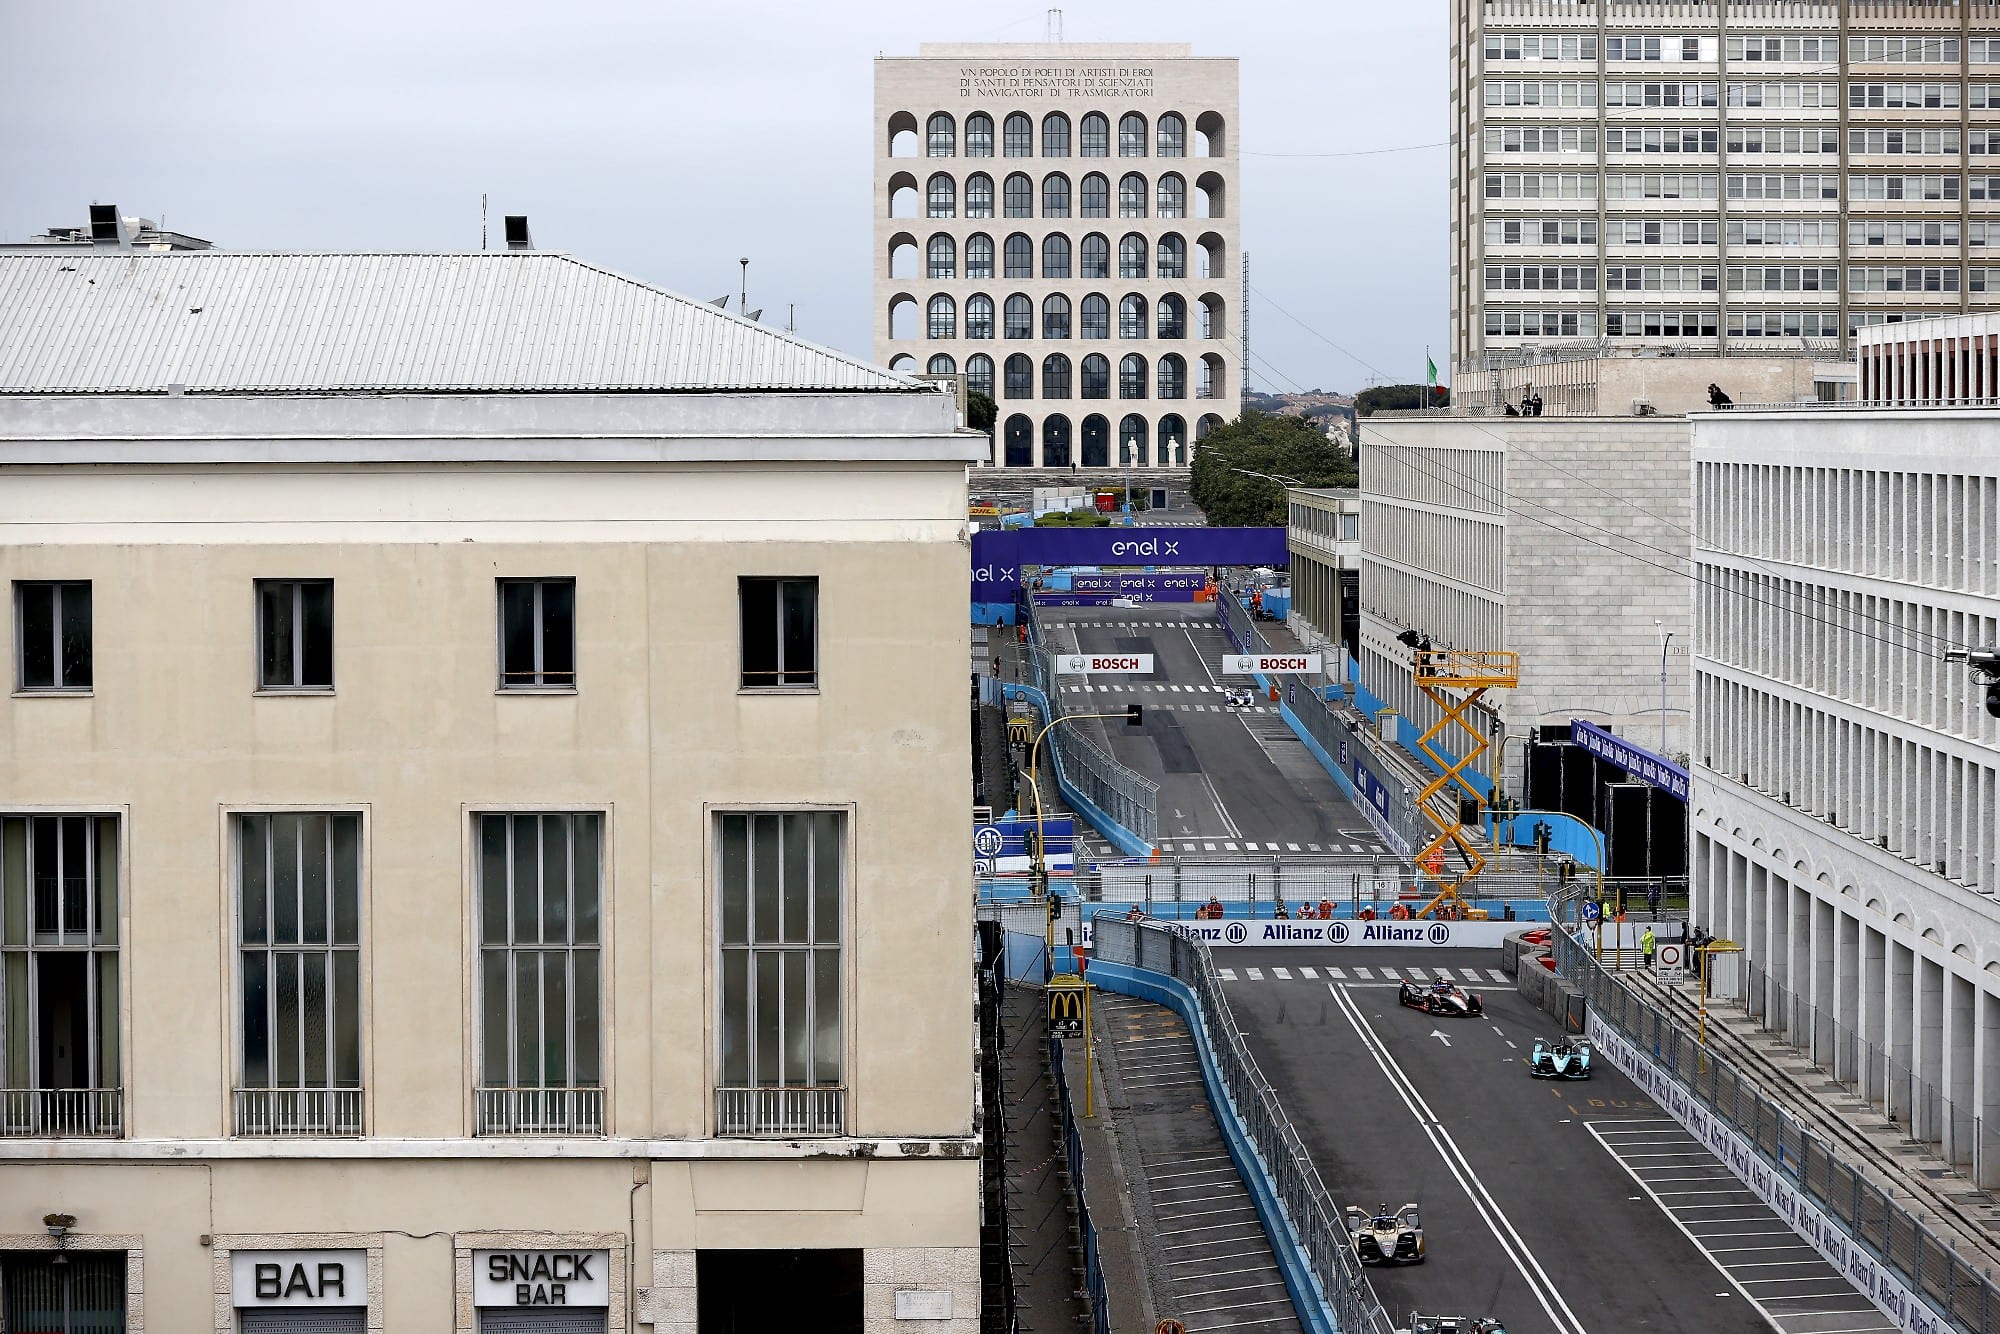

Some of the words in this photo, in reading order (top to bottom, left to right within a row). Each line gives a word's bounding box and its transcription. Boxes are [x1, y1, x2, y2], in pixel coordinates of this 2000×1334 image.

[980, 68, 1018, 77] POPOLO
[1022, 68, 1031, 77] DI
[1035, 68, 1062, 77] POETI
[1065, 68, 1075, 77] DI
[1079, 68, 1116, 77] ARTISTI
[1119, 68, 1129, 77] DI
[1132, 68, 1153, 77] EROI
[960, 78, 970, 87] DI
[974, 78, 1006, 87] SANTI
[1009, 78, 1020, 87] DI
[1023, 78, 1080, 87] PENSATORI
[1084, 78, 1095, 87] DI
[1098, 78, 1153, 87] SCIENZIATI
[960, 88, 970, 97] DI
[977, 88, 1043, 97] NAVIGATORI
[1050, 88, 1060, 97] DI
[1067, 88, 1153, 97] TRASMIGRATORI
[1111, 537, 1159, 556] enel
[971, 564, 994, 582] el
[1077, 578, 1102, 588] enel
[1121, 578, 1145, 588] enel
[1164, 577, 1189, 588] enel
[1092, 658, 1139, 670] BOSCH
[1260, 658, 1307, 670] BOSCH
[1262, 924, 1323, 940] Allianz
[1363, 925, 1424, 940] Allianz
[487, 1253, 594, 1282] SNACK
[254, 1263, 345, 1299] BAR
[515, 1283, 567, 1305] BAR
[1878, 1275, 1898, 1316] Allianz
